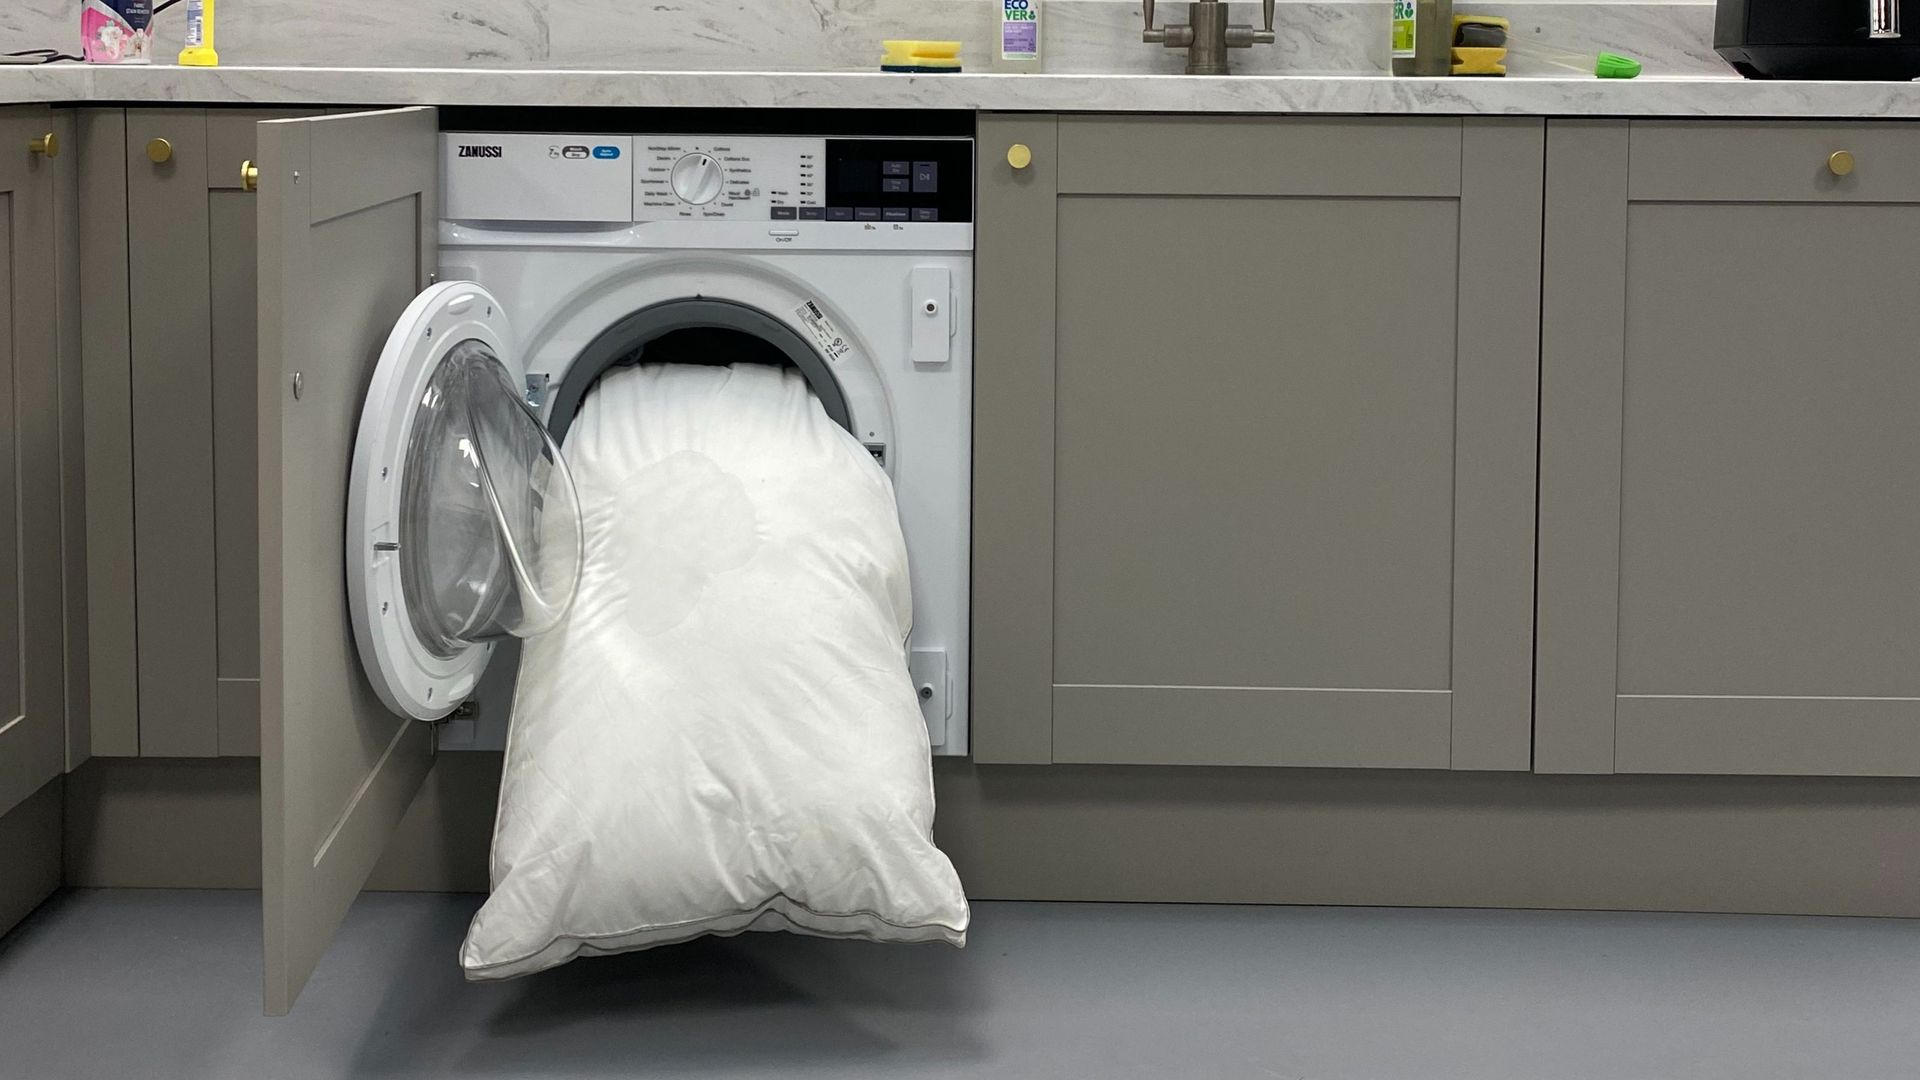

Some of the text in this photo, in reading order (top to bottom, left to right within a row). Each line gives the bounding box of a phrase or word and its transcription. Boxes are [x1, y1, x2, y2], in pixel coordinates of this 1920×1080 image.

[1004, 0, 1029, 10] ECO
[1005, 10, 1028, 20] VER
[458, 145, 503, 158] ZANUSSI
